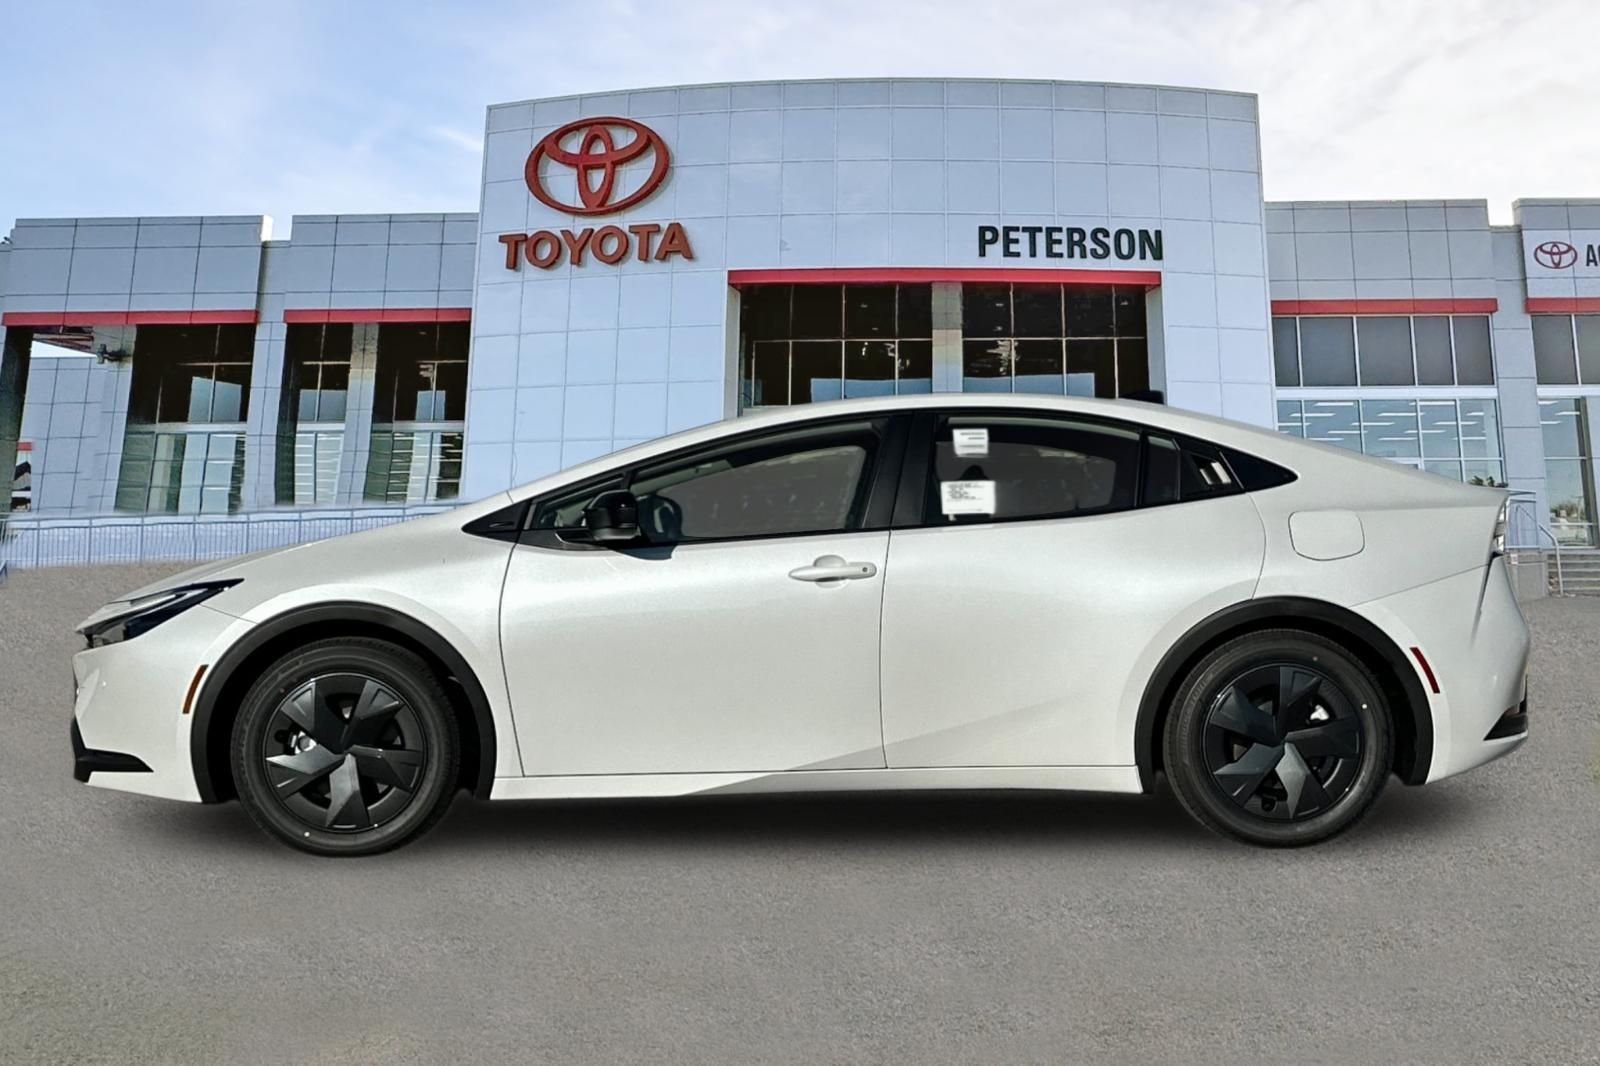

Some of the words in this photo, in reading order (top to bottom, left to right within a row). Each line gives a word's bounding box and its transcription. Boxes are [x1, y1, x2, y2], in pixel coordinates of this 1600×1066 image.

[498, 222, 693, 270] TOYOTA
[978, 225, 1164, 261] PETERSON
[1586, 244, 1600, 267] A
